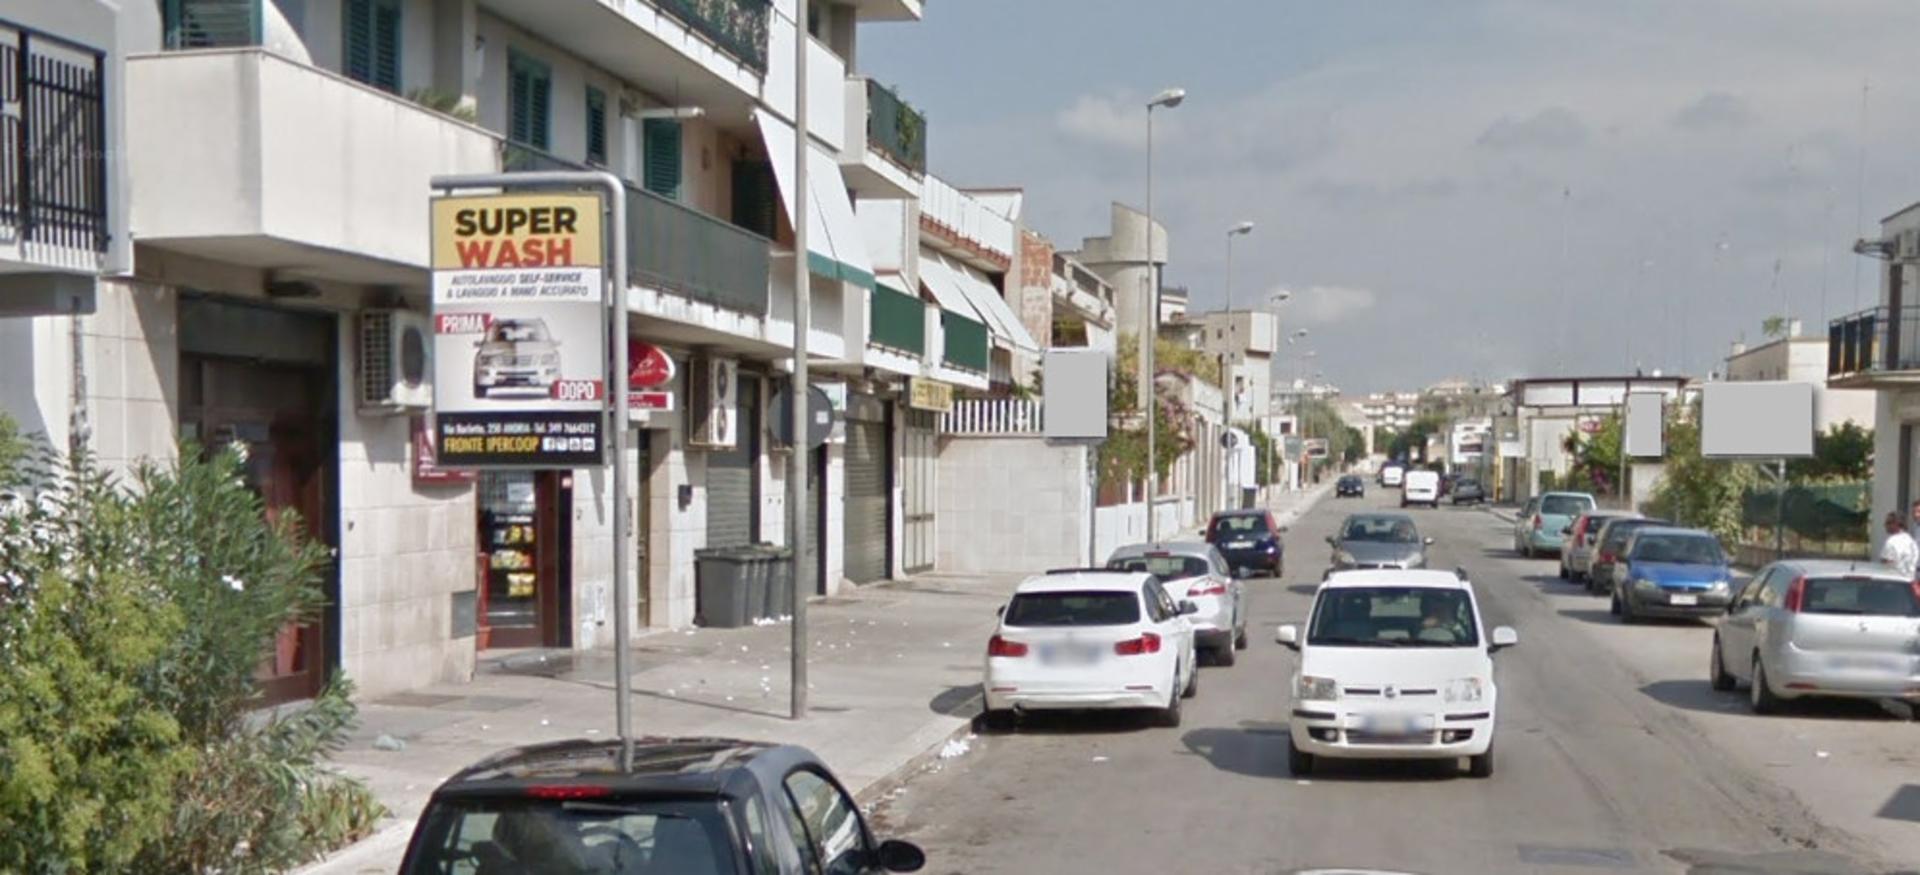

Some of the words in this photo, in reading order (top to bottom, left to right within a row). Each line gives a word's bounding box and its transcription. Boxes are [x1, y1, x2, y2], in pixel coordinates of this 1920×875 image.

[455, 206, 577, 236] SUPER
[456, 237, 573, 267] WASH
[452, 274, 516, 285] AUTOLAVAGGIO
[519, 272, 582, 284] SELF-SERVICE
[456, 287, 498, 298] LAVAGGIO
[500, 286, 507, 296] A
[511, 286, 537, 296] MANO
[540, 285, 589, 296] ACCURATO
[441, 316, 485, 334] PRIMA
[558, 381, 596, 399] DOPO
[444, 437, 484, 452] FRONTE
[486, 436, 540, 452] IPERCOOP
